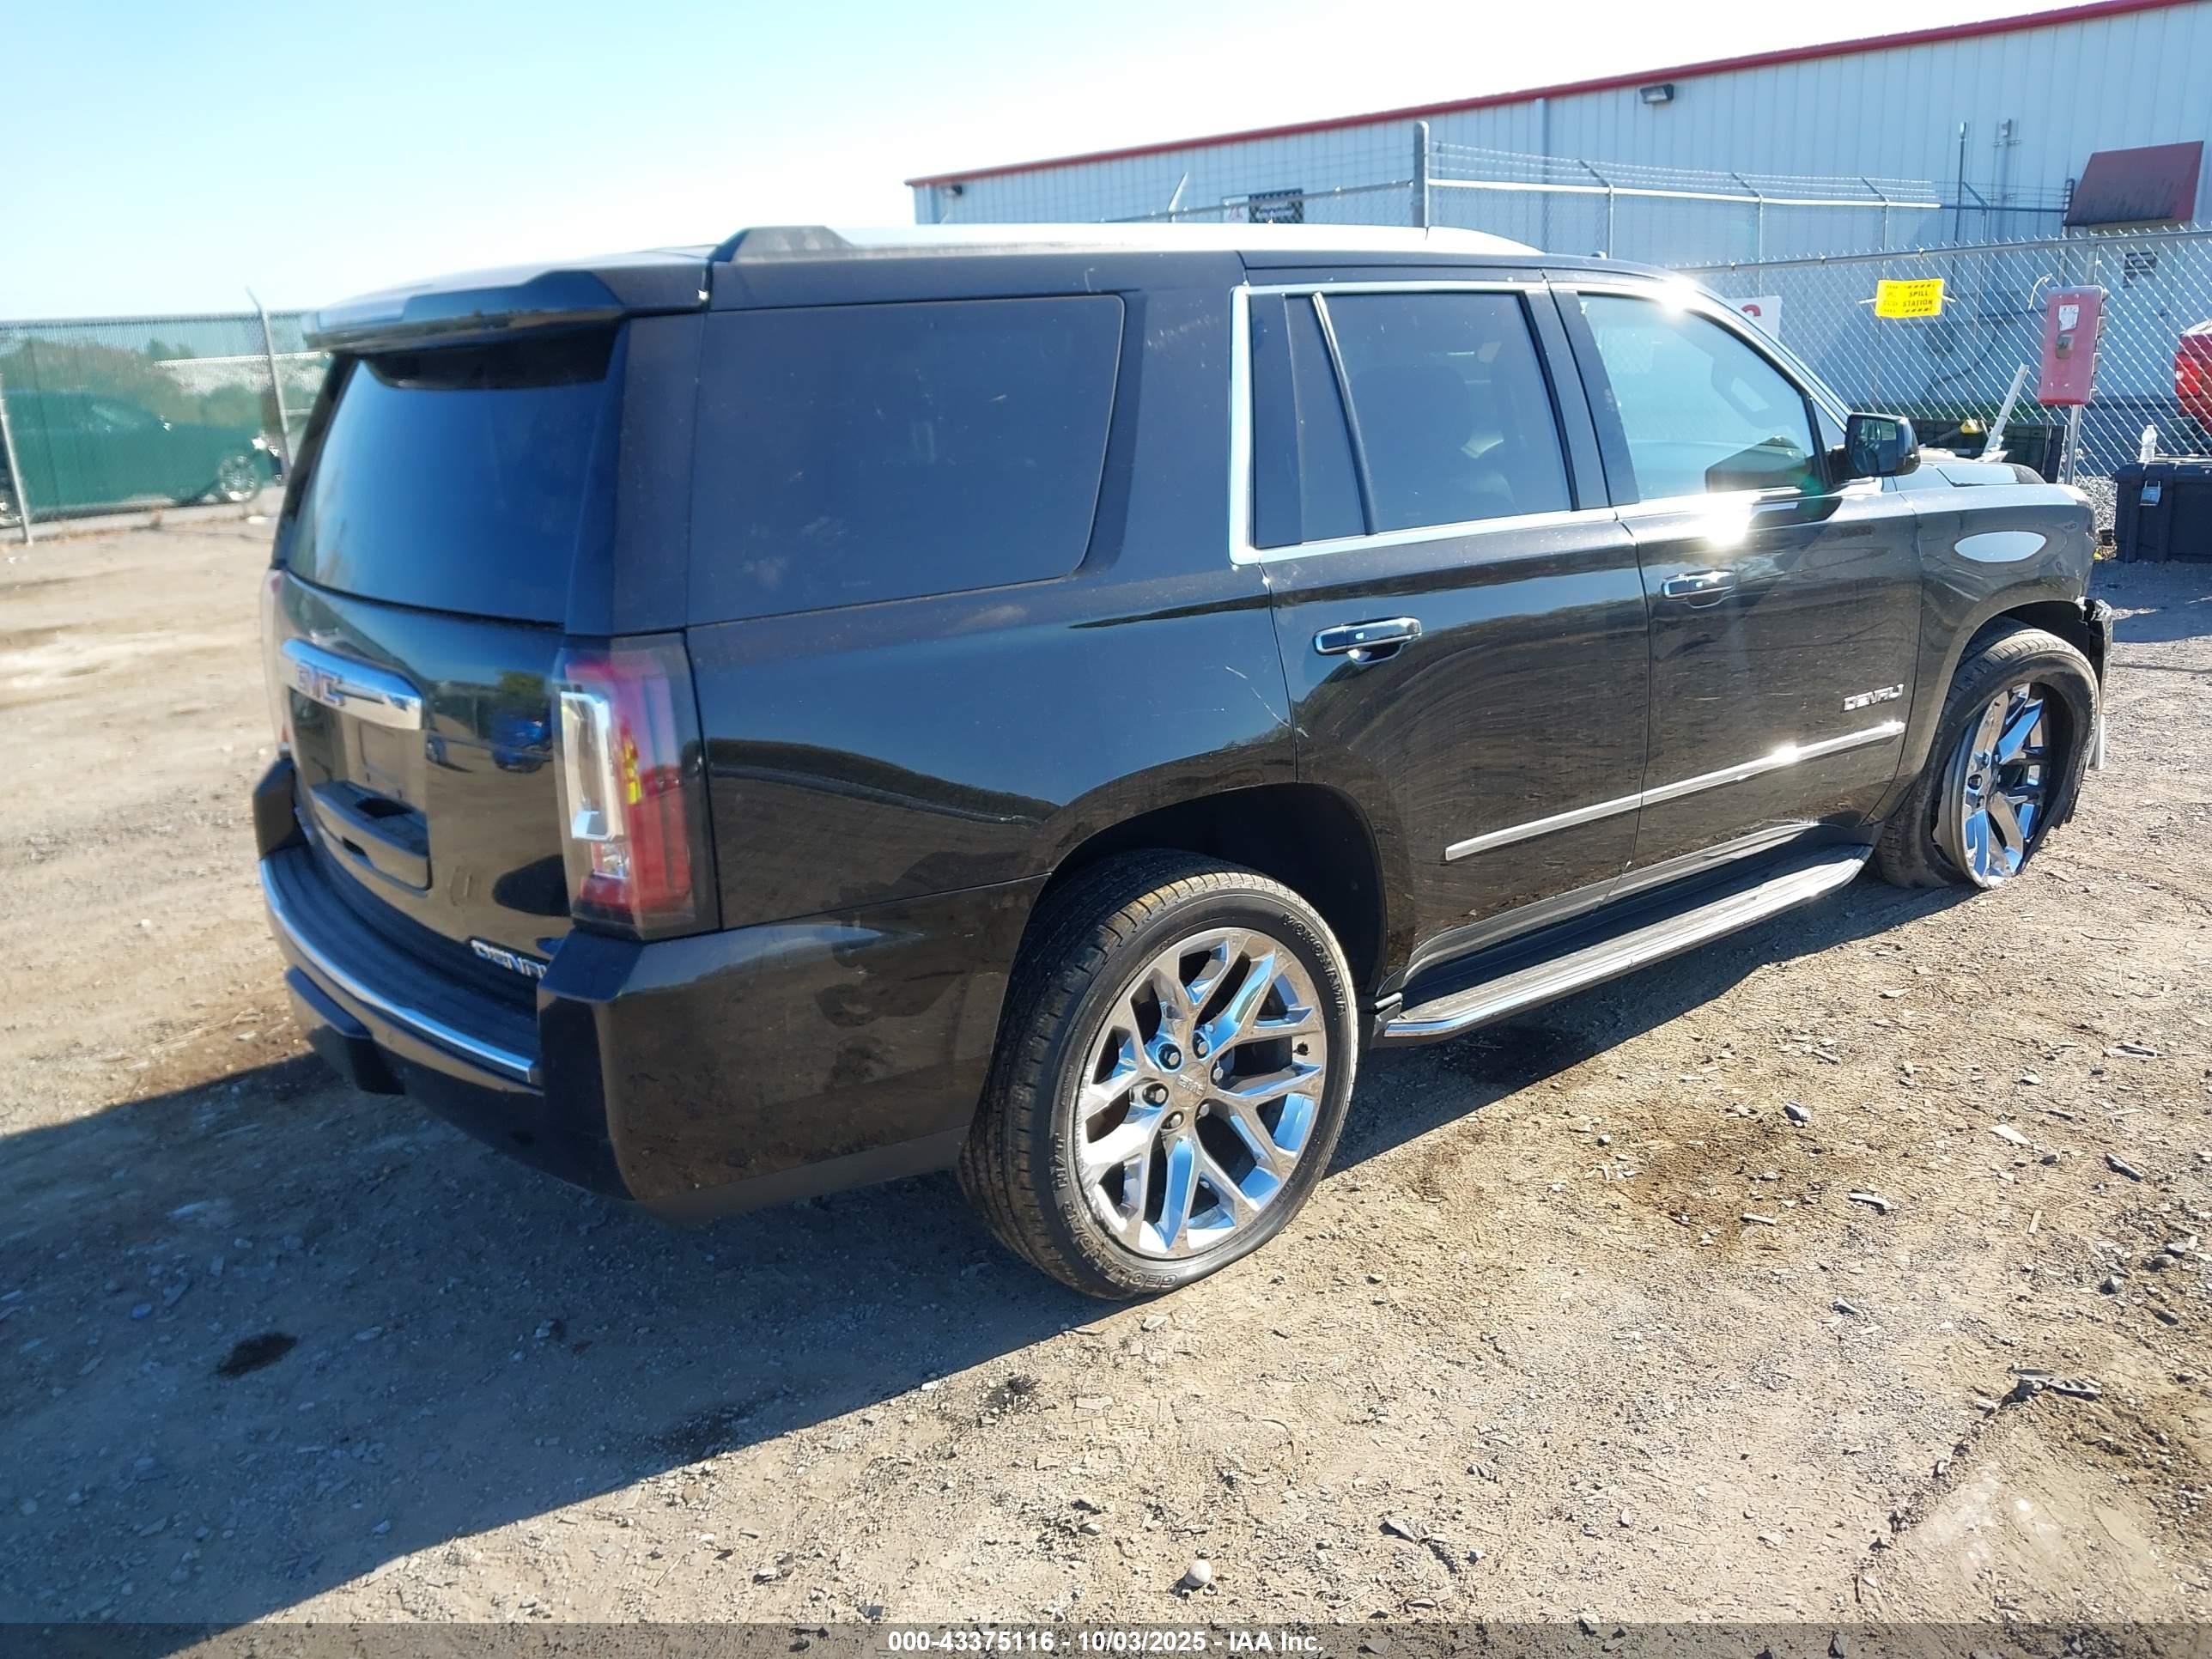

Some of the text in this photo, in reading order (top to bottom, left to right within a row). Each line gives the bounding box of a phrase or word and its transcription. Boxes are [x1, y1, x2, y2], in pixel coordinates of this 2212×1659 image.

[1903, 299, 1934, 307] STATION
[1843, 684, 1905, 711] DENALI
[470, 939, 547, 979] DENA
[1282, 911, 1347, 1020] YOKOHAMA
[1176, 1073, 1206, 1097] GMC
